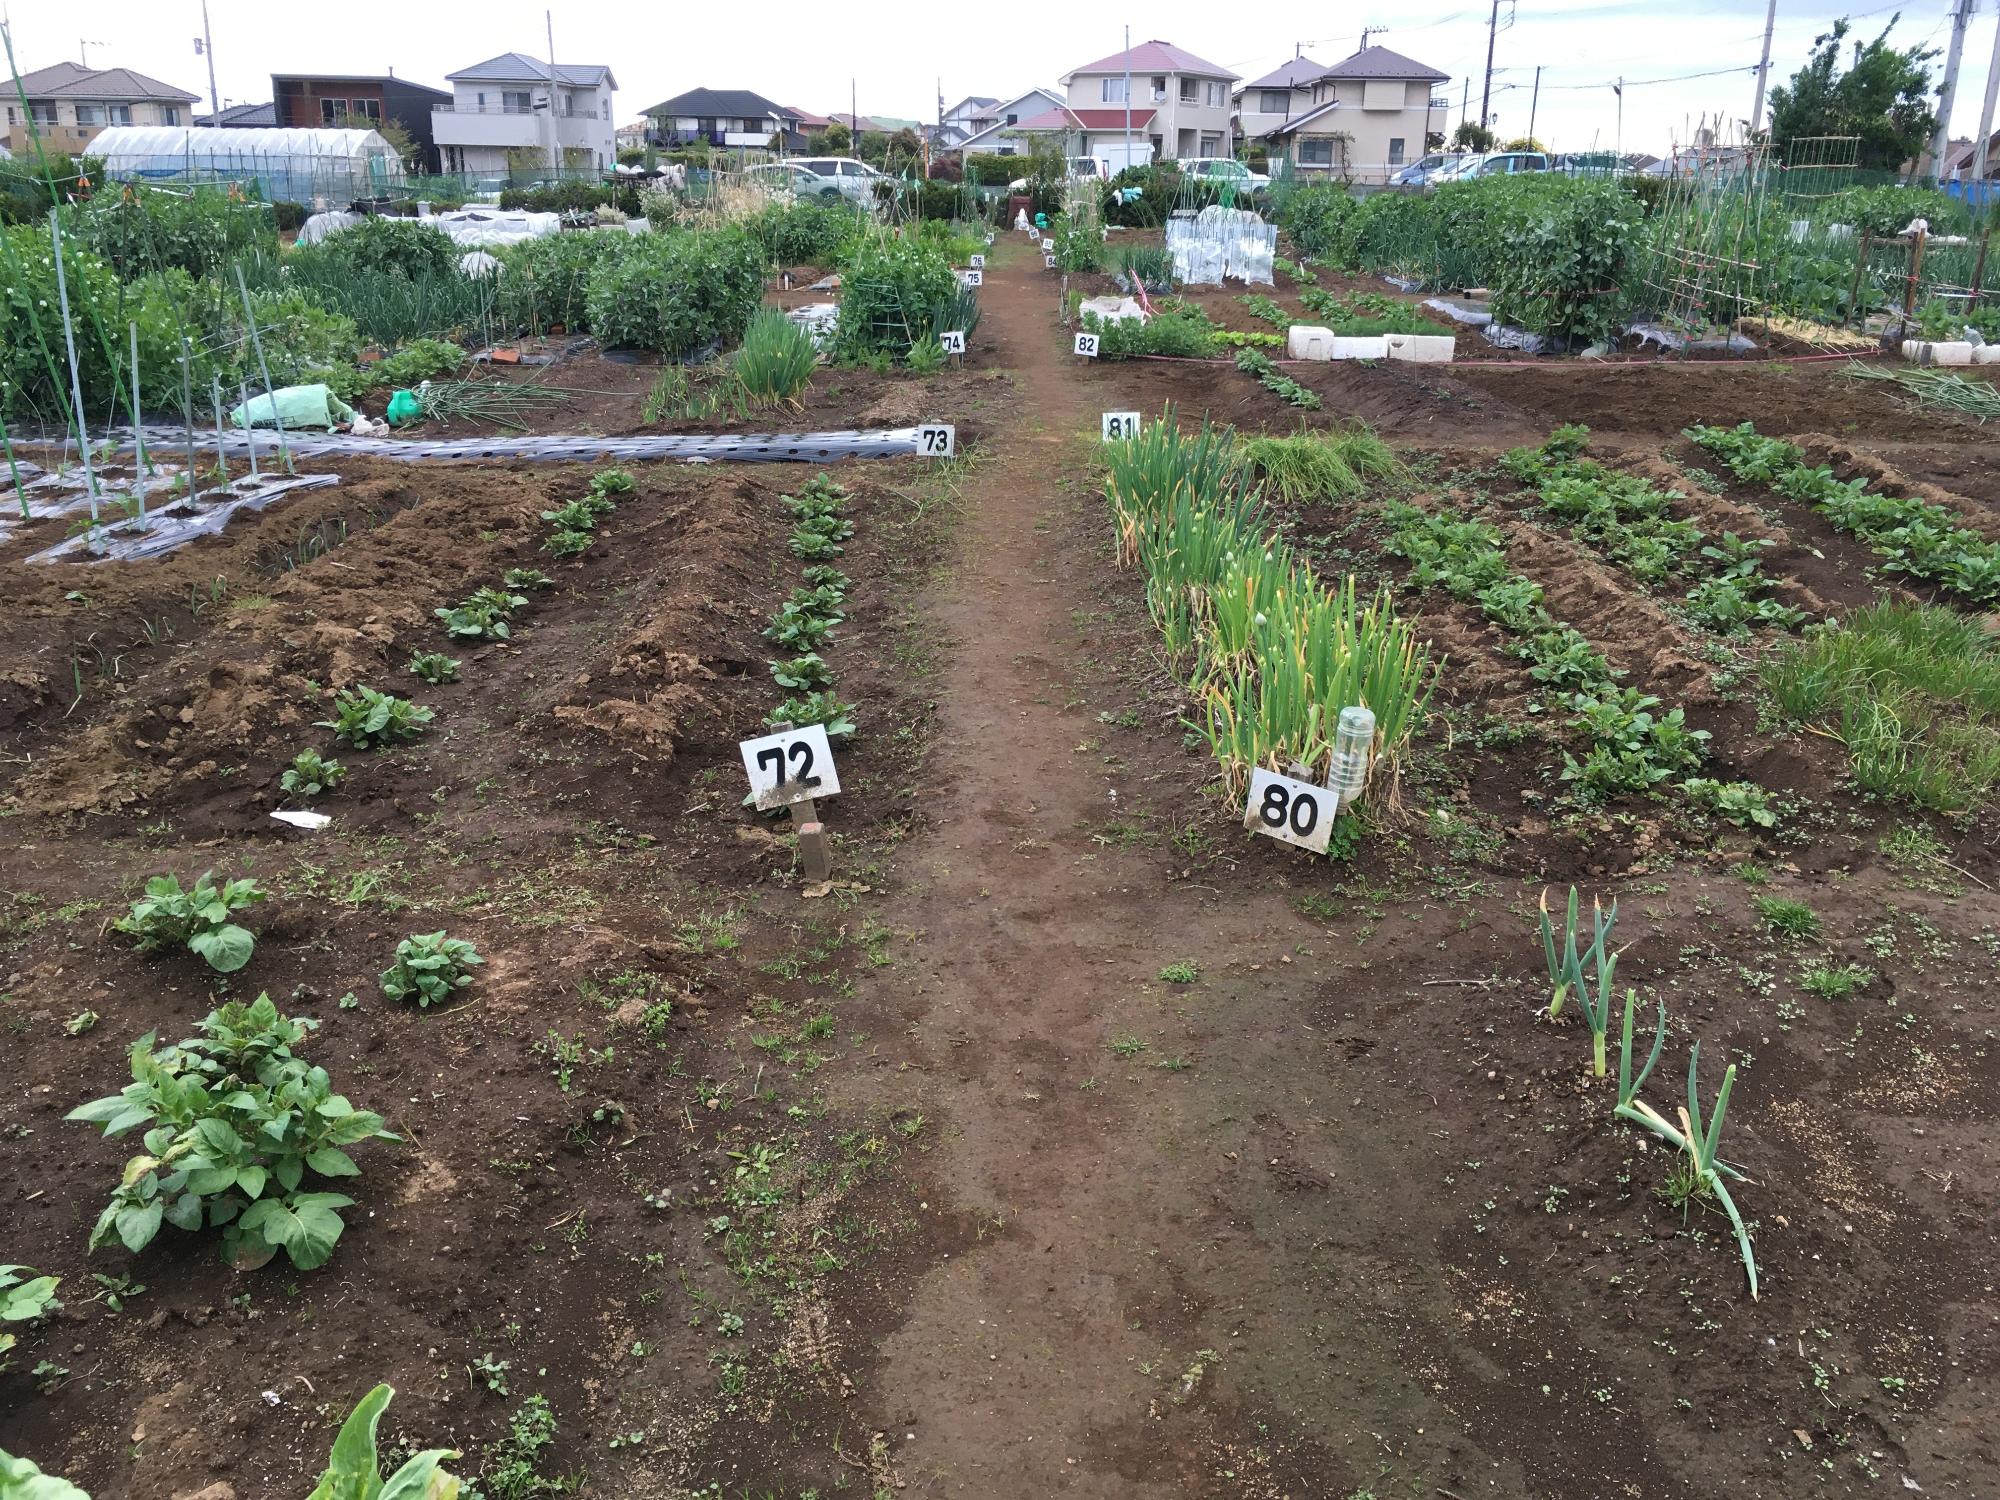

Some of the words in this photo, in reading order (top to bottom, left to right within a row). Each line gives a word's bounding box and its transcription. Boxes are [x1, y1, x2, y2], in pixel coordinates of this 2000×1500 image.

[973, 257, 982, 265] 76
[1048, 258, 1056, 266] 84
[968, 274, 979, 284] 75
[944, 336, 960, 350] 74
[1079, 337, 1094, 352] 82
[1110, 418, 1131, 439] 81
[923, 430, 947, 451] 73
[757, 741, 822, 789] 72
[1260, 784, 1318, 837] 80
